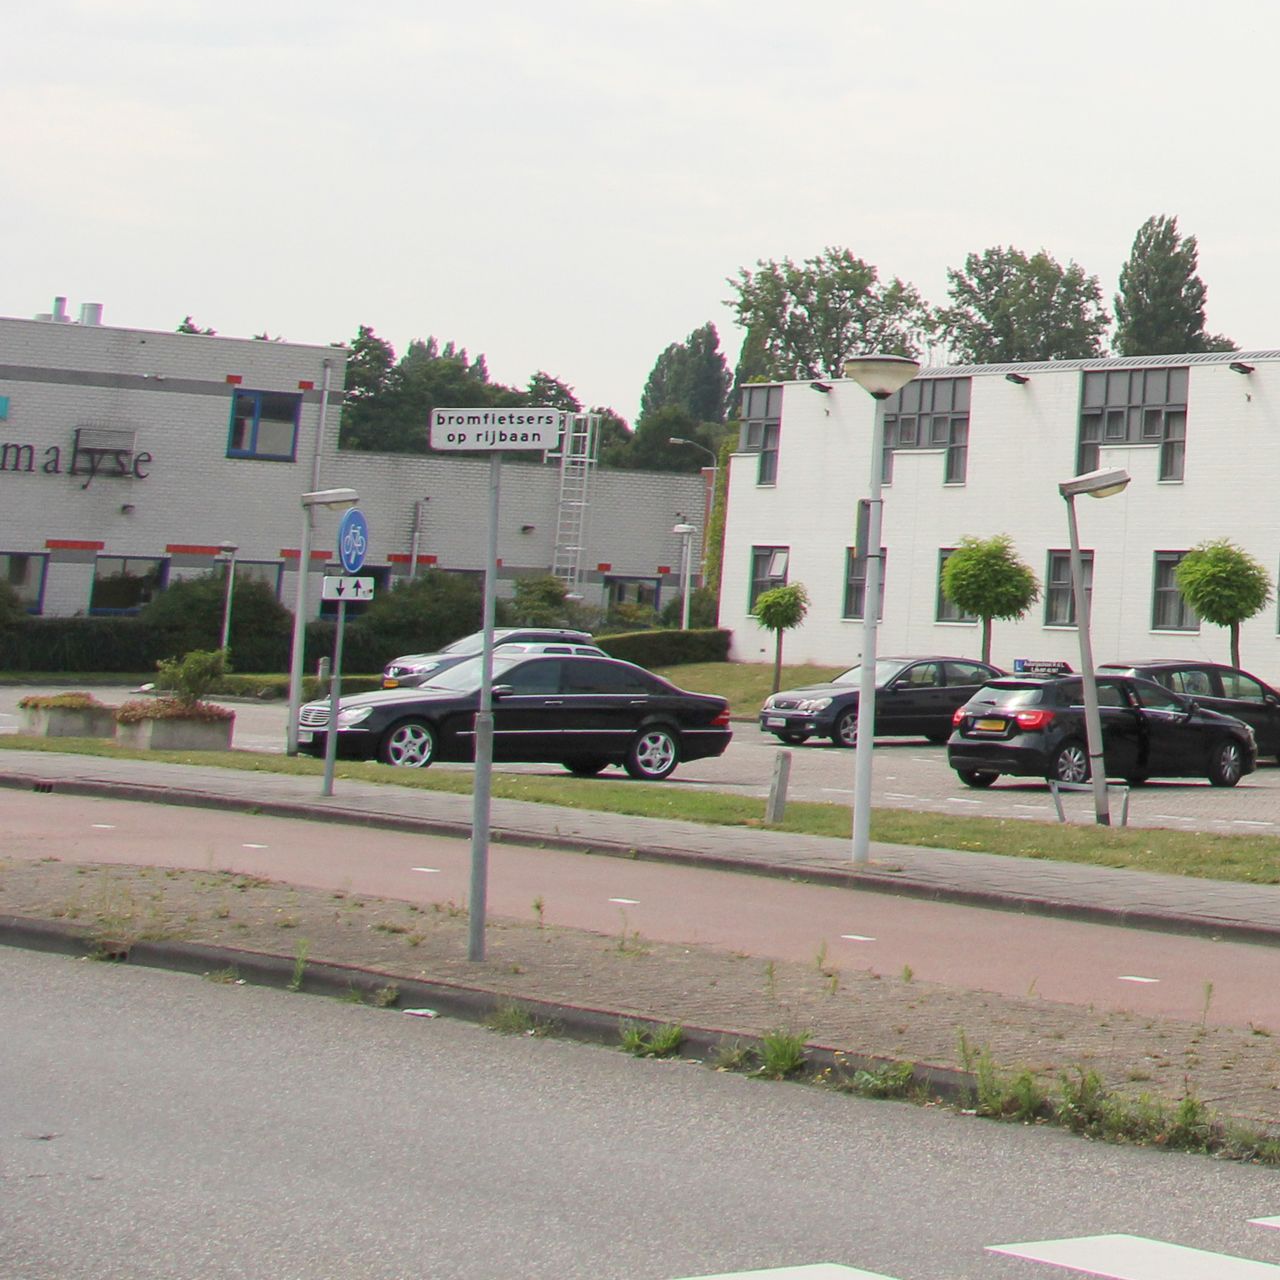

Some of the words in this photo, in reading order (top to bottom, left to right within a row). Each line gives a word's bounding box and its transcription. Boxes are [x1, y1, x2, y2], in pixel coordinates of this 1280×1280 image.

[436, 413, 553, 425] bromfietsers
[447, 433, 466, 443] op
[476, 431, 541, 445] rijbaan
